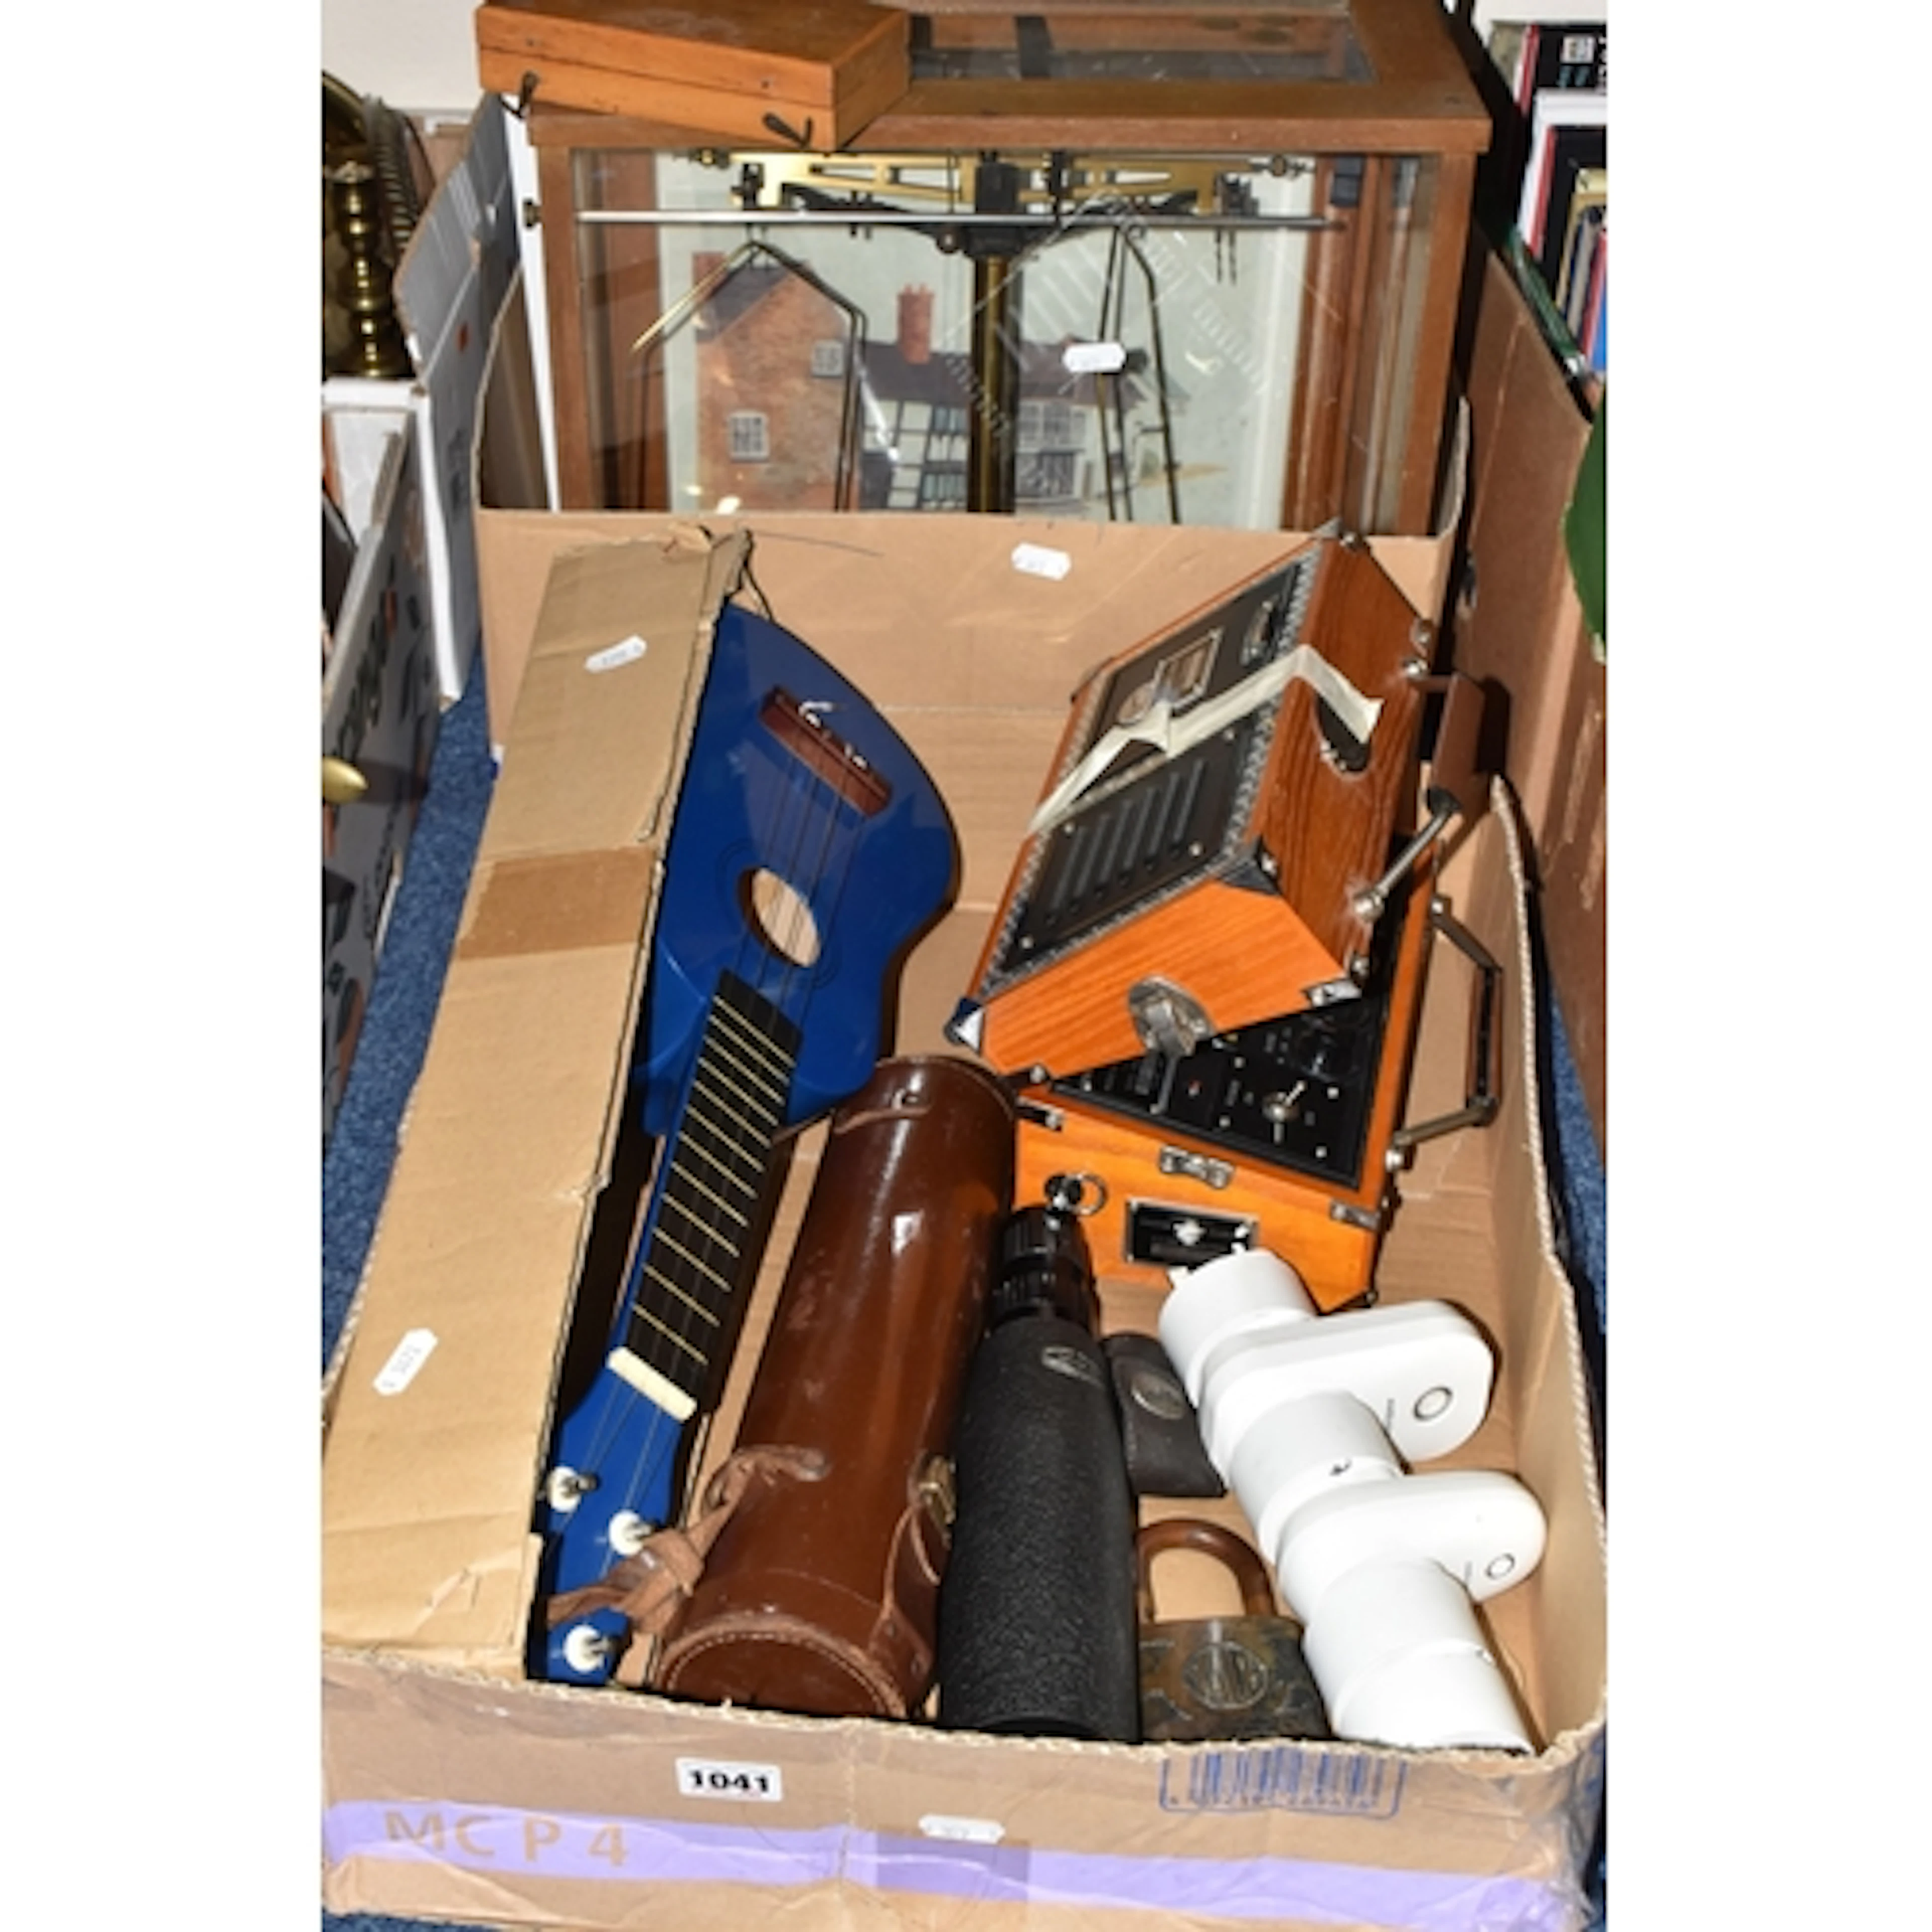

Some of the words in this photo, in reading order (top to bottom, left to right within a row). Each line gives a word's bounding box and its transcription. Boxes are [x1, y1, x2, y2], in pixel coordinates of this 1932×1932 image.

[690, 1769, 769, 1793] 1041
[523, 1815, 561, 1862] P
[588, 1823, 628, 1867] 4
